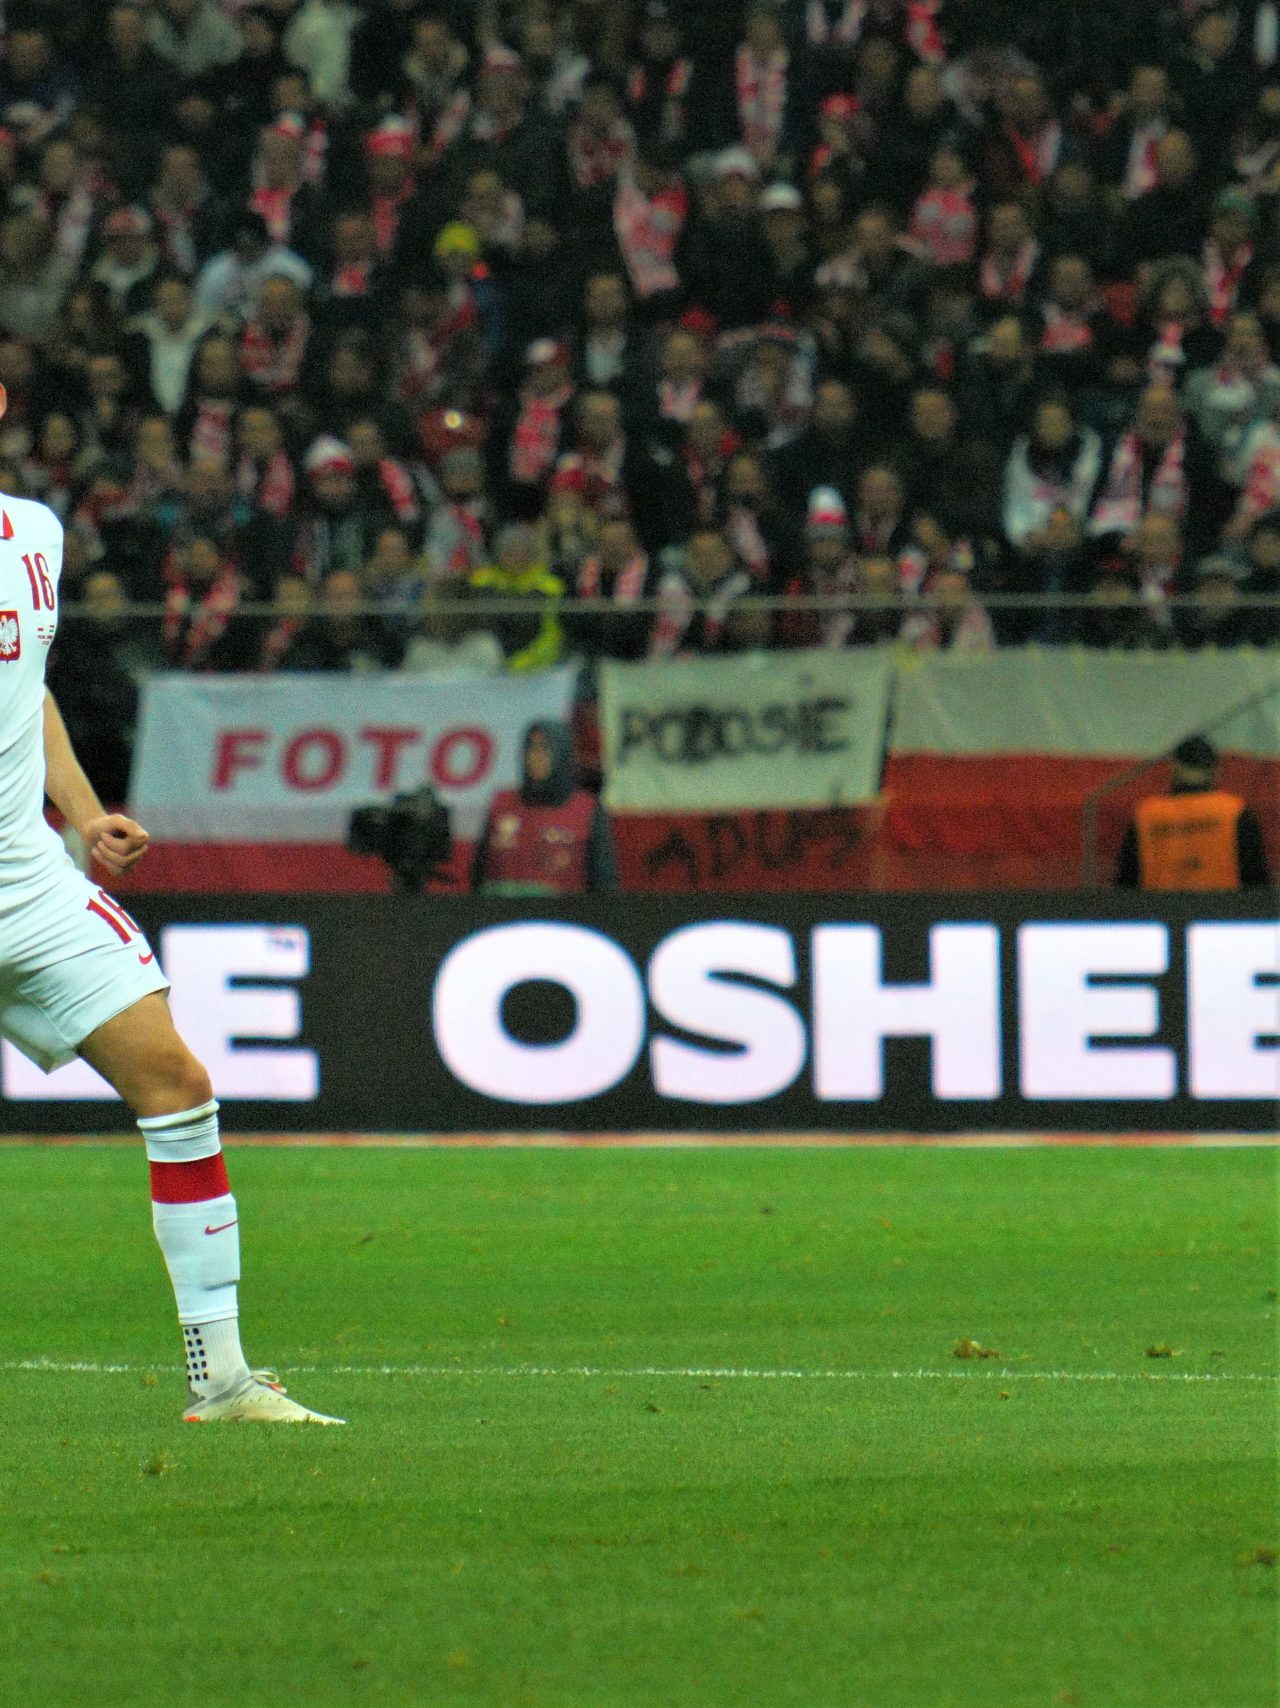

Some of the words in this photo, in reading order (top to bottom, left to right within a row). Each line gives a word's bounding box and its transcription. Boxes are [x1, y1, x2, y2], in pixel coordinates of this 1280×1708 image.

[21, 552, 55, 611] 16
[211, 723, 496, 792] FOTO
[433, 920, 1280, 1104] OSHEE
